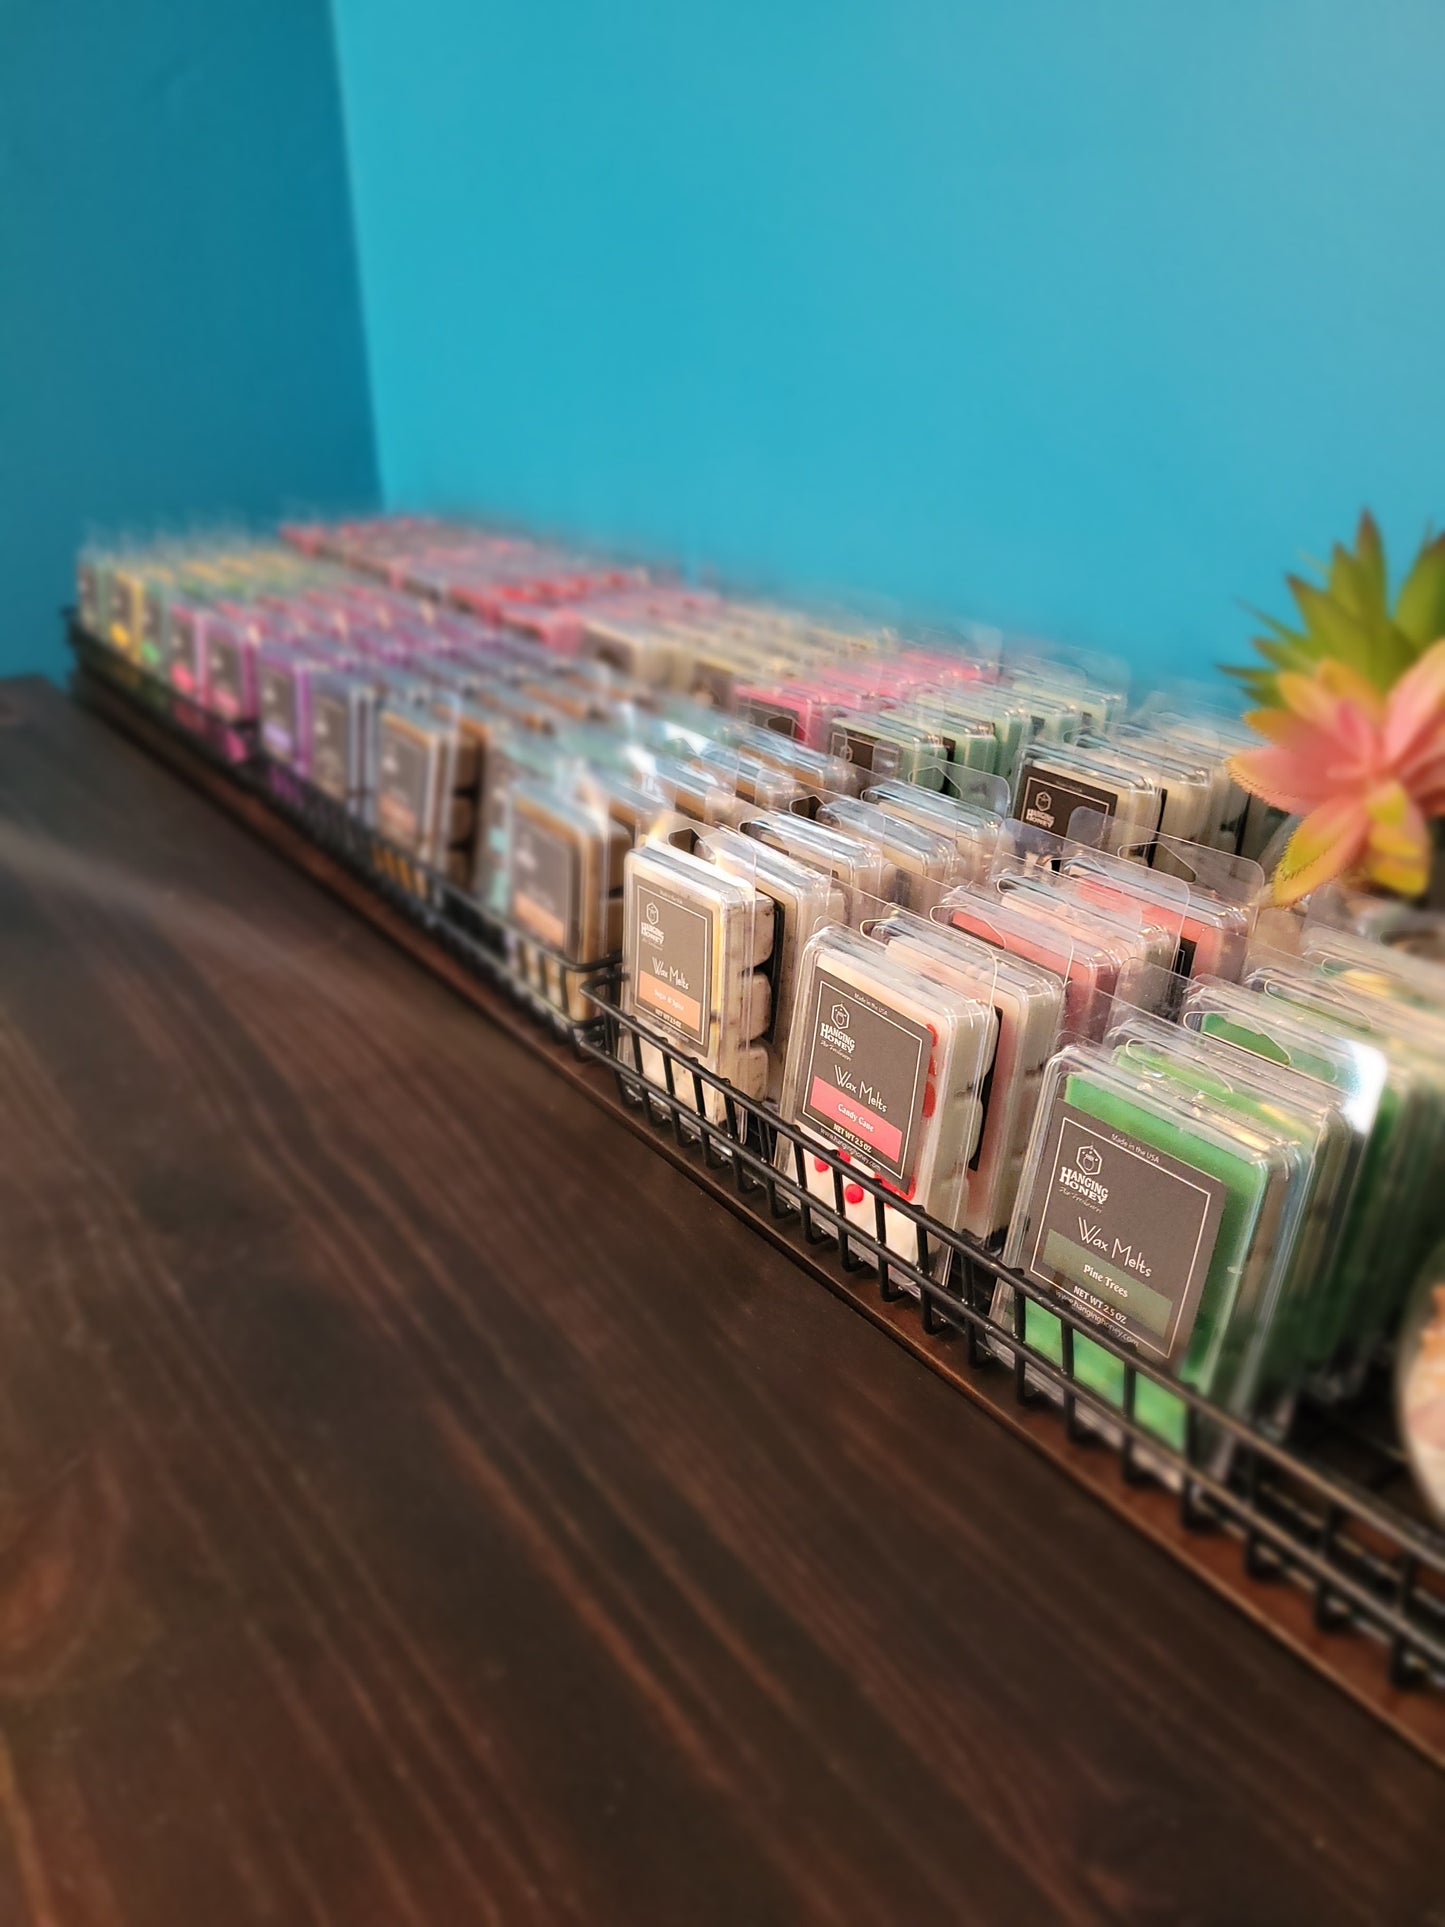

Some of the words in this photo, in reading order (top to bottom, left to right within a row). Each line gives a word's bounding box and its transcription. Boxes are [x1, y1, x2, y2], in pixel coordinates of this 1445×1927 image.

[820, 1022, 855, 1049] HANGING
[820, 1026, 854, 1054] HONEY
[834, 1064, 857, 1094] Wax
[859, 1081, 888, 1113] Melts
[837, 1103, 857, 1122] Candy
[858, 1117, 875, 1133] Cane
[833, 1123, 845, 1135] NET
[845, 1130, 855, 1142] WT
[863, 1143, 872, 1153] OZ
[1111, 1133, 1128, 1147] Made
[1128, 1142, 1135, 1151] in
[1135, 1145, 1147, 1157] the
[1146, 1151, 1160, 1164] USA
[1059, 1166, 1109, 1199] HANGING
[1059, 1170, 1107, 1205] HONEY
[1078, 1216, 1109, 1252] Wax
[1111, 1238, 1152, 1278] Melts
[1083, 1264, 1102, 1283] Pine
[1104, 1276, 1128, 1298] Trees
[1073, 1285, 1089, 1300] NET
[1090, 1295, 1104, 1309] WT
[1103, 1304, 1115, 1317] 2.5
[1115, 1312, 1127, 1324] OZ
